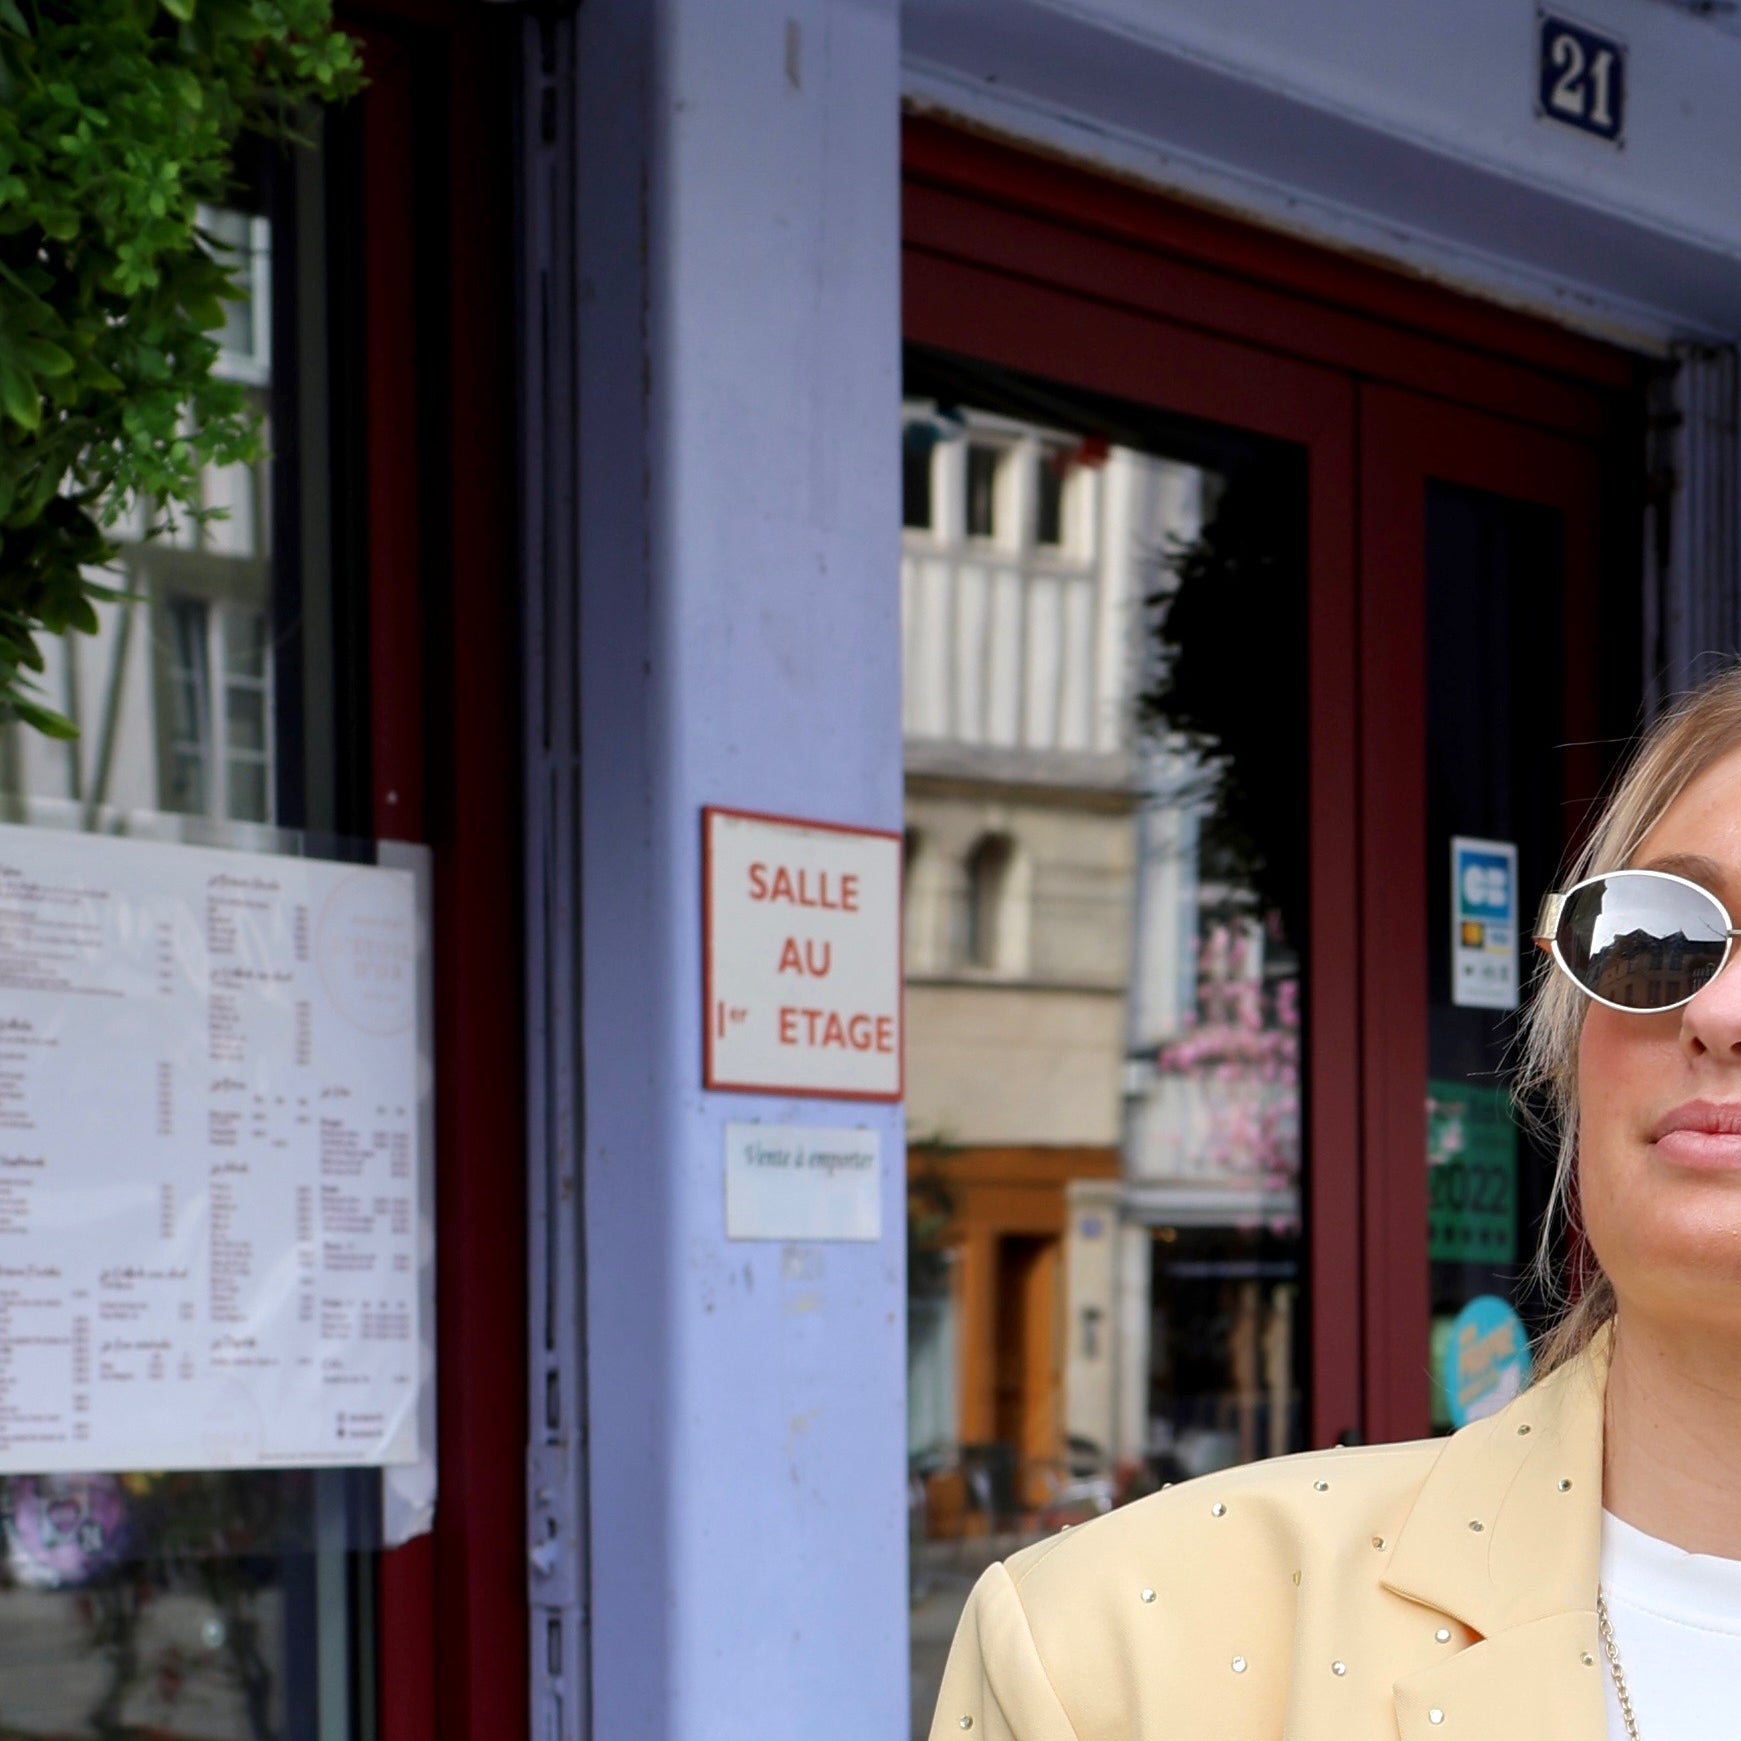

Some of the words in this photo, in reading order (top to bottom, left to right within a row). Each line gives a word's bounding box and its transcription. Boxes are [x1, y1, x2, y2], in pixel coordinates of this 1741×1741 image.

[1551, 34, 1613, 125] 21
[748, 862, 859, 912] SALLE
[777, 935, 832, 979] AU
[778, 1006, 894, 1054] ETAGE
